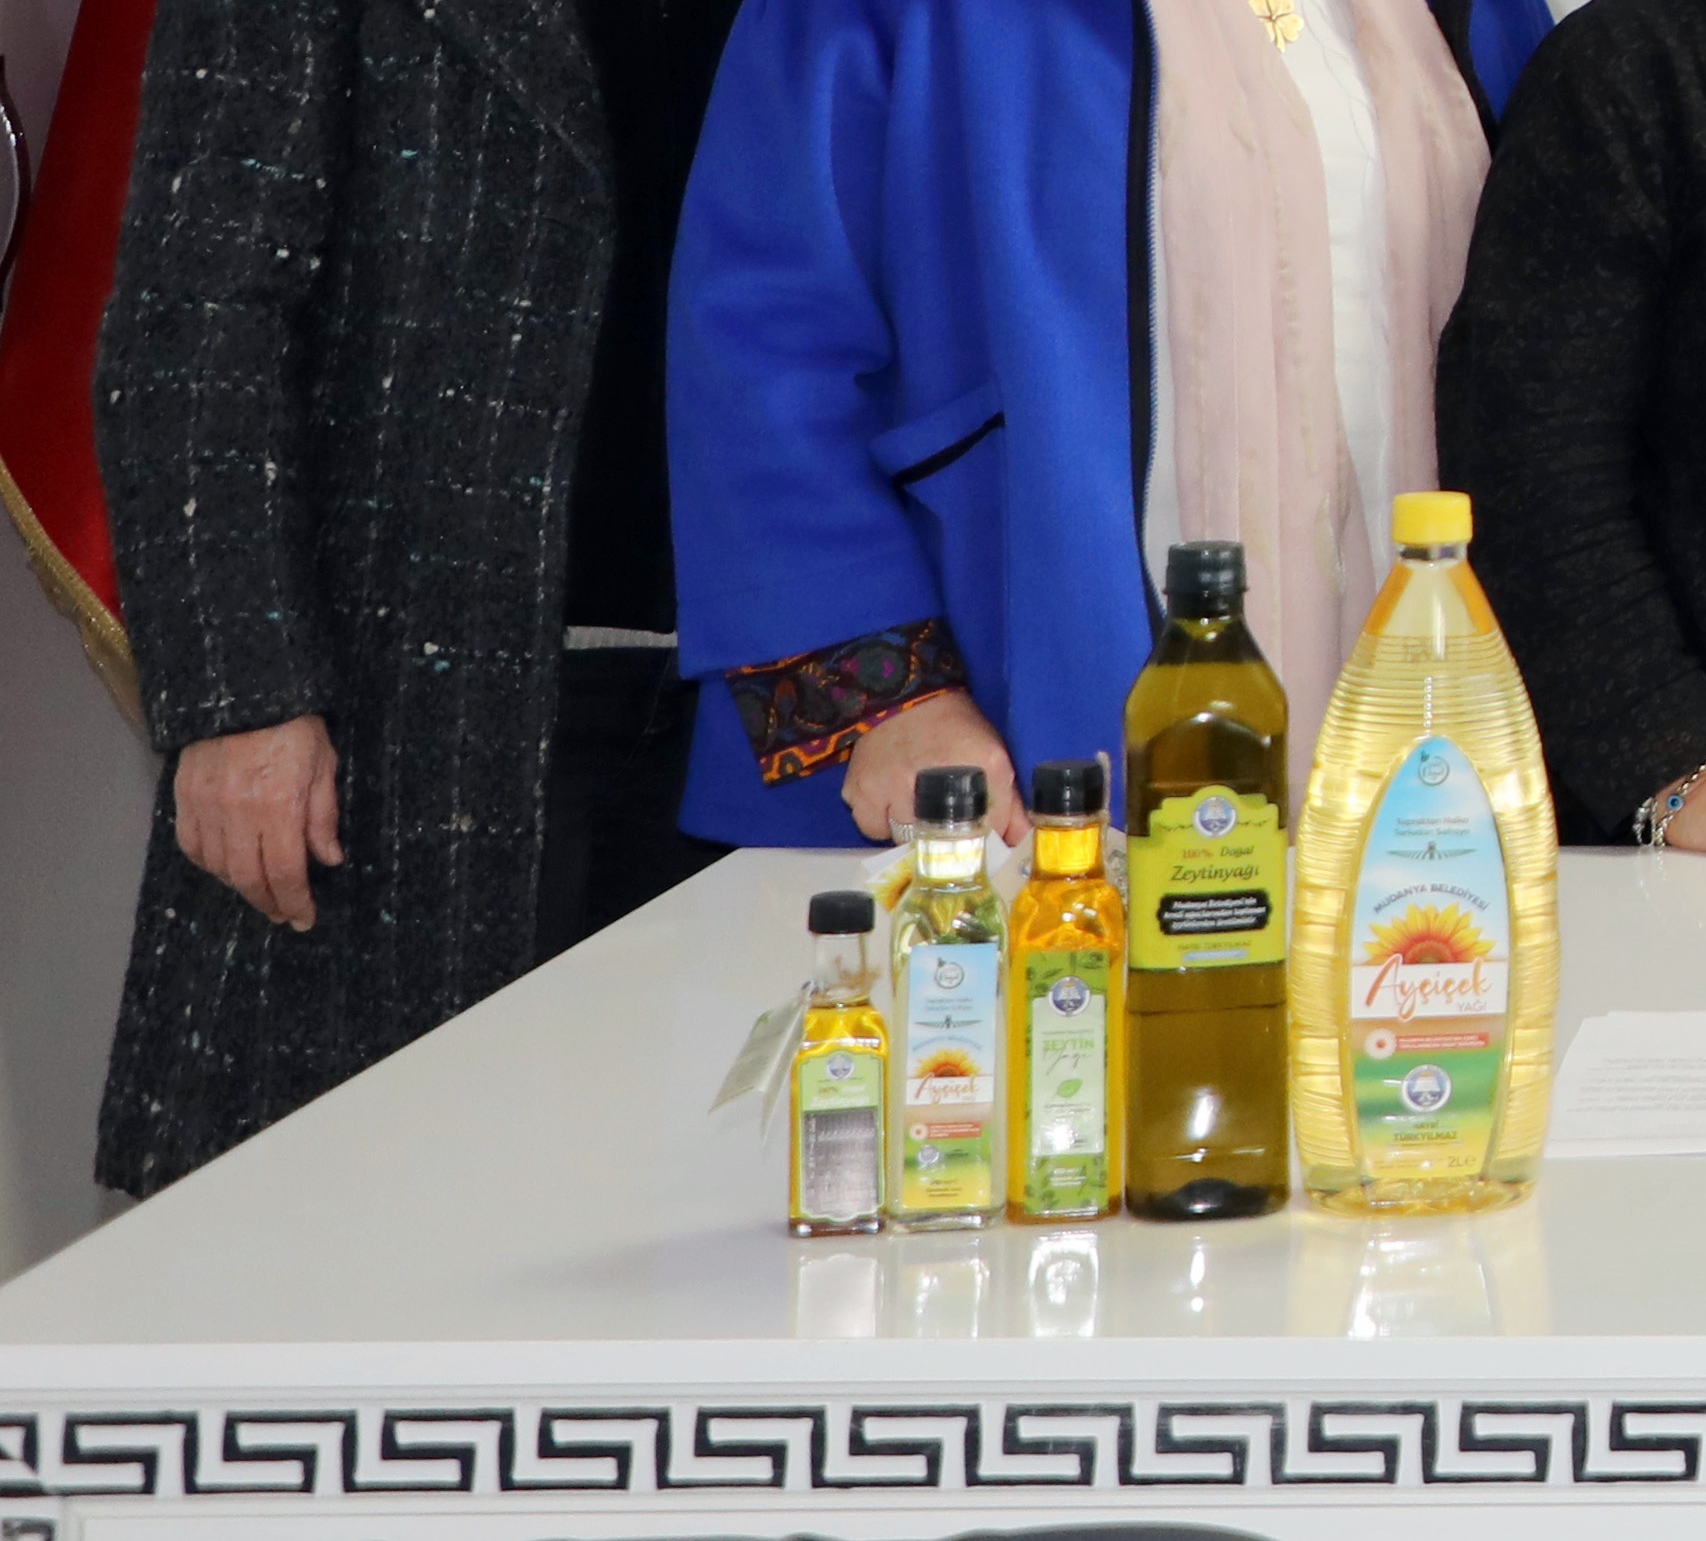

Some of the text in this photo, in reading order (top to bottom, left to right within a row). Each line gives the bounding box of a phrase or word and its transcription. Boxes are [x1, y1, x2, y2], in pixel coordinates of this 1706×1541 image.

[1170, 863, 1260, 884] Zeytinyağı
[1373, 882, 1491, 915] MUDANYA BELEDİYESİ
[1365, 953, 1493, 1022] Ayçiçek
[1458, 999, 1487, 1012] YAĞI
